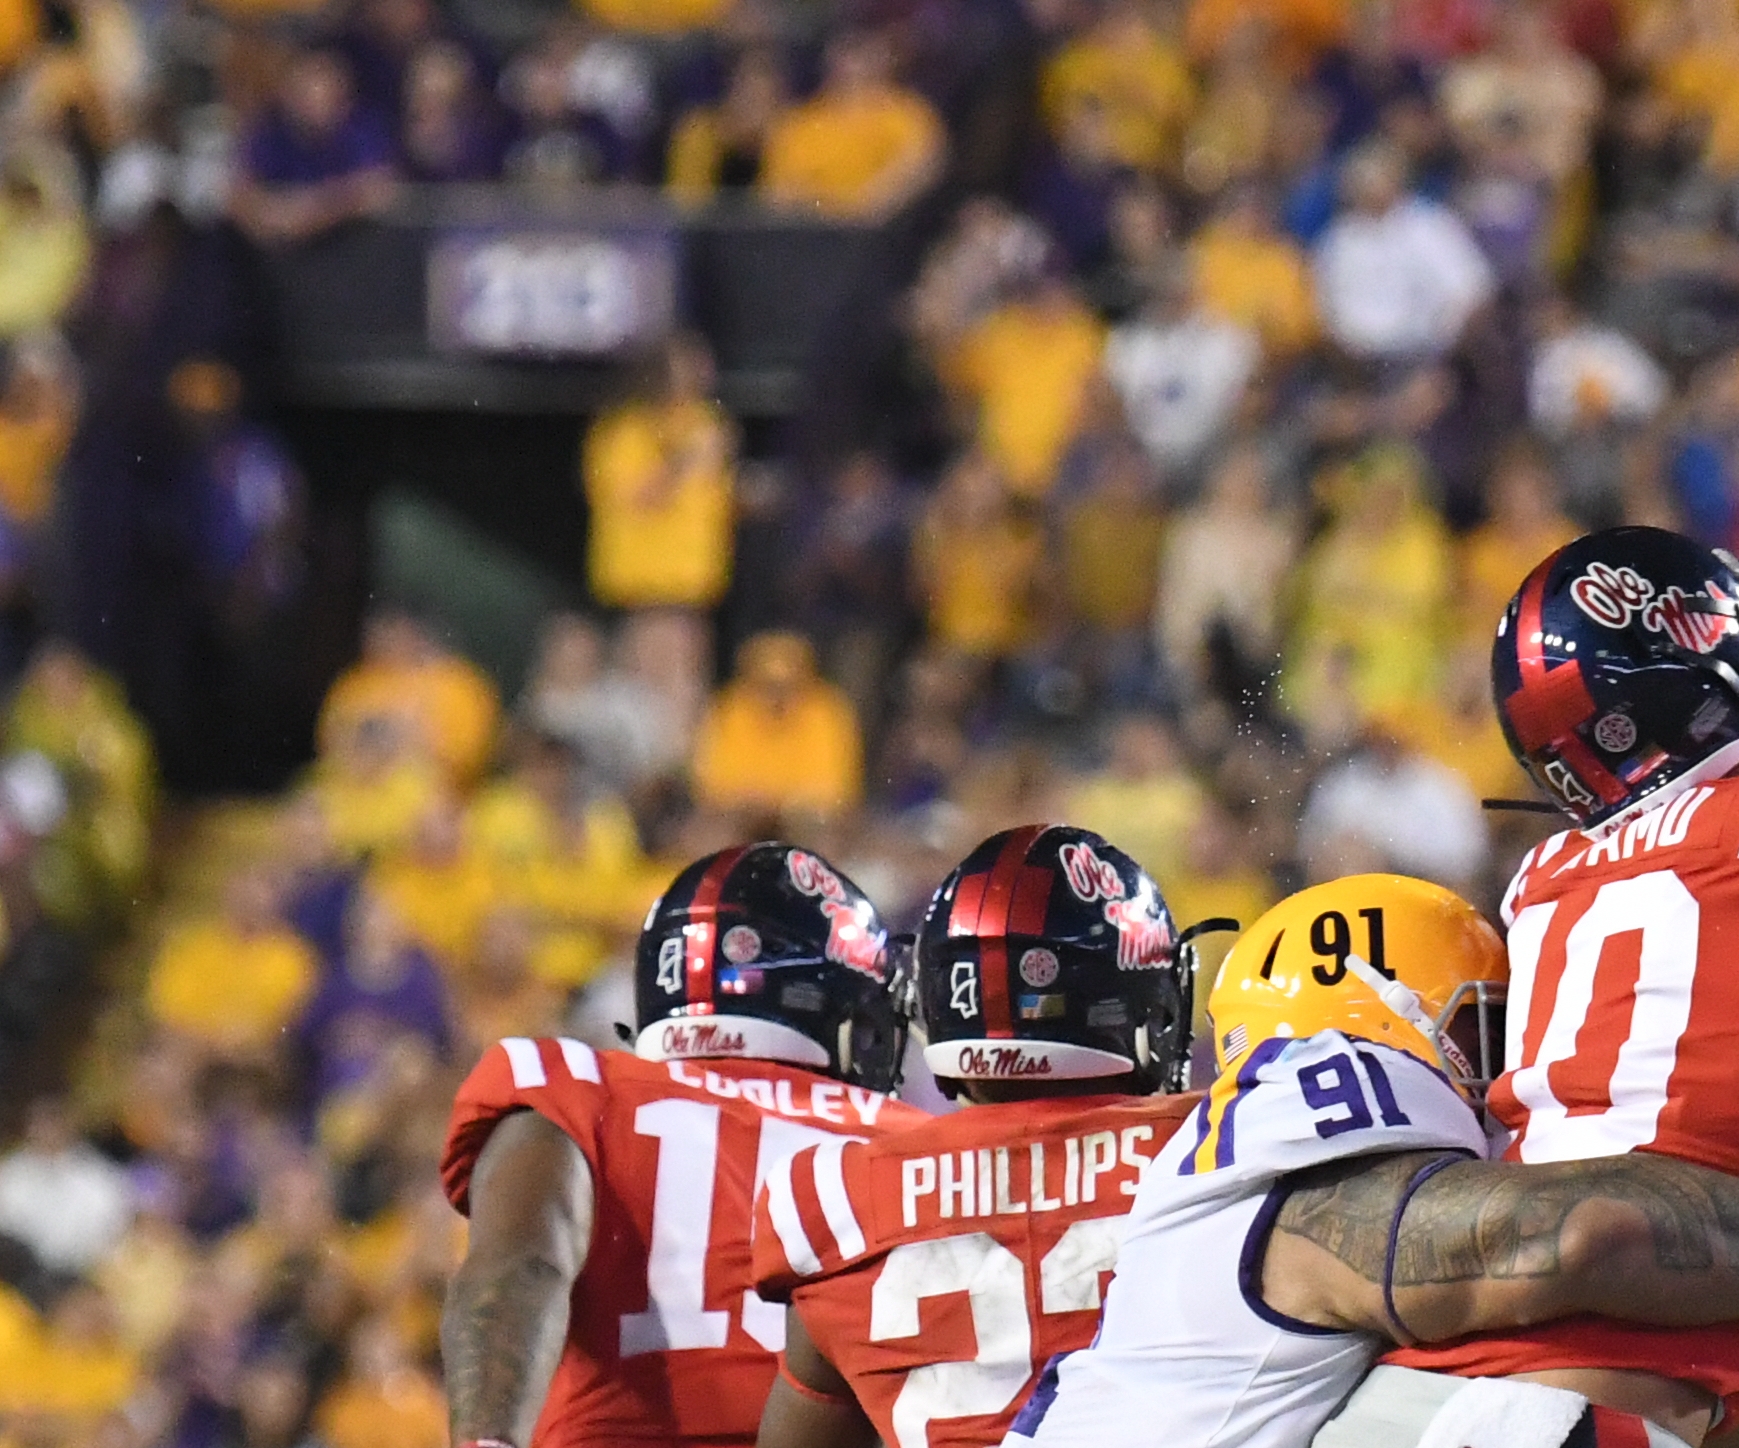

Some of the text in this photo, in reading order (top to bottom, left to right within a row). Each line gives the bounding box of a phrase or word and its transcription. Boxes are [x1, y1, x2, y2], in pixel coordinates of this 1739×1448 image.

[1570, 562, 1655, 629] Ole
[1059, 842, 1125, 902] Ole
[1310, 907, 1396, 986] 91
[690, 1023, 746, 1052] Miss
[1505, 869, 1700, 1165] 10
[958, 1048, 1053, 1076] Ole Miss
[1296, 1052, 1411, 1139] 91
[902, 1125, 1154, 1228] PHILLIPS
